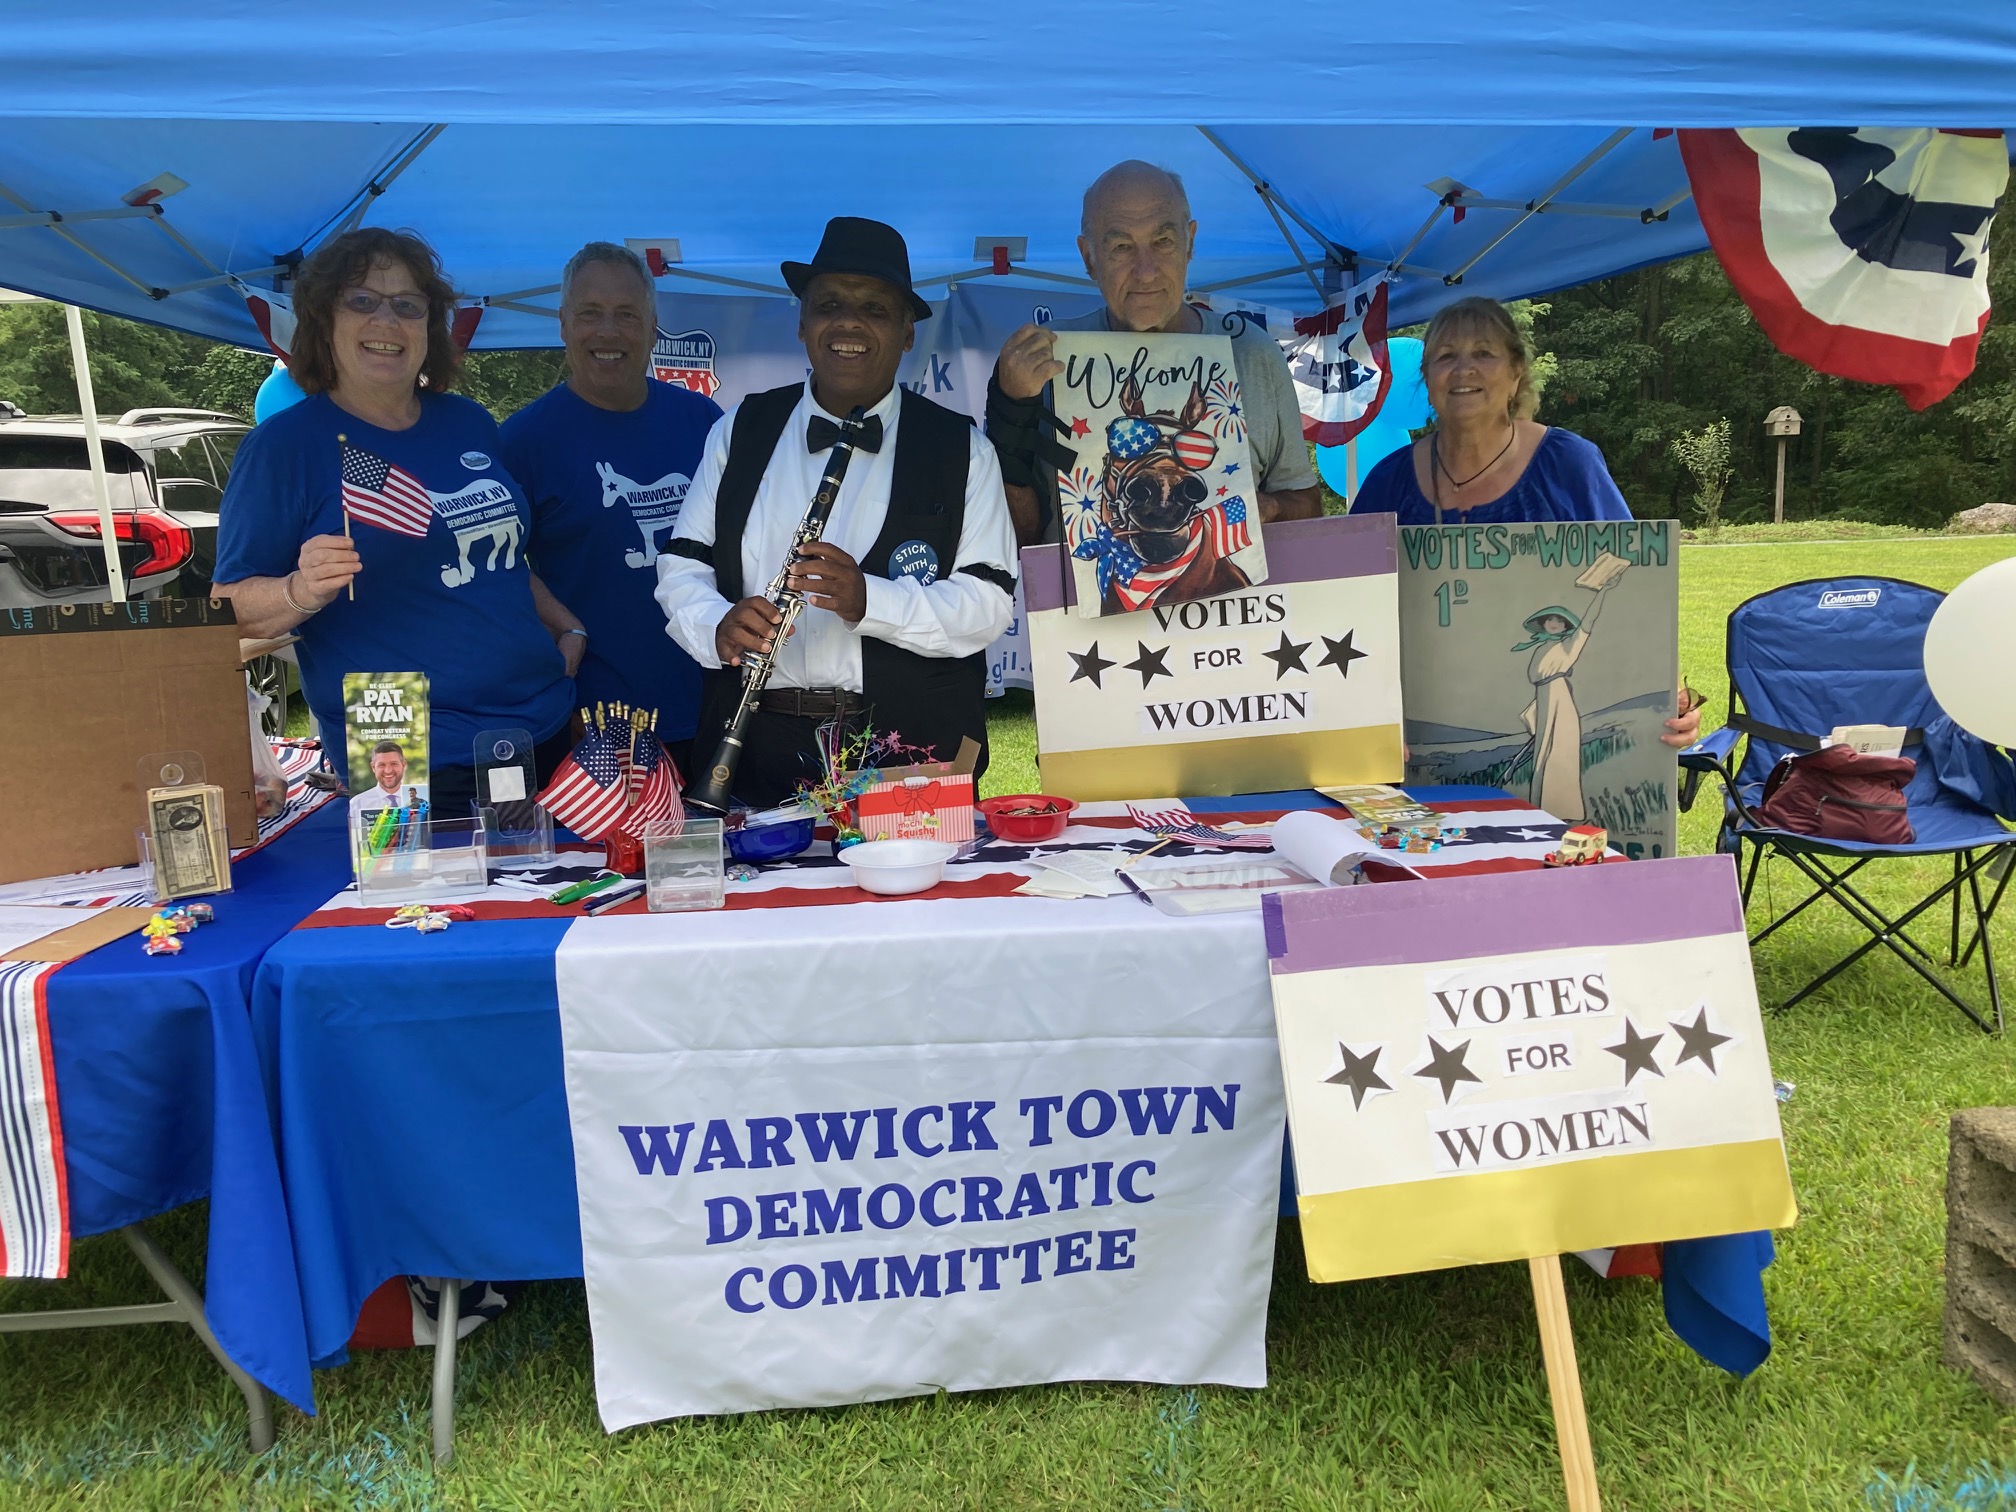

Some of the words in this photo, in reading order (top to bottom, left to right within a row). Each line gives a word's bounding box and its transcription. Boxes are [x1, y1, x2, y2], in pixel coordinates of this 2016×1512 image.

[1066, 346, 1227, 409] Welcome
[446, 511, 484, 529] DEMOCRATIC
[484, 502, 517, 519] COMMITTEE
[631, 506, 665, 517] DEMOCRATIC
[895, 544, 927, 563] STICK
[1402, 525, 1511, 570] VOTES
[1511, 532, 1538, 556] FOR
[1534, 521, 1668, 568] WOMEN
[902, 558, 928, 574] WITH
[1151, 593, 1287, 632] VOTES
[1824, 593, 1867, 604] Coleman
[1193, 647, 1243, 670] FOR
[363, 689, 404, 706] PAT
[1144, 691, 1308, 732] WOMEN
[356, 705, 414, 723] RYAN
[896, 826, 935, 839] Squishy
[897, 820, 922, 830] mochi
[1432, 973, 1610, 1028] VOTES
[1507, 1042, 1573, 1073] FOR
[618, 1101, 998, 1177] WARWICK
[1019, 1082, 1242, 1148] TOWN
[1434, 1101, 1651, 1168] WOMEN
[703, 1158, 1157, 1246] DEMOCRATIC
[724, 1227, 1137, 1315] COMMITTEE
